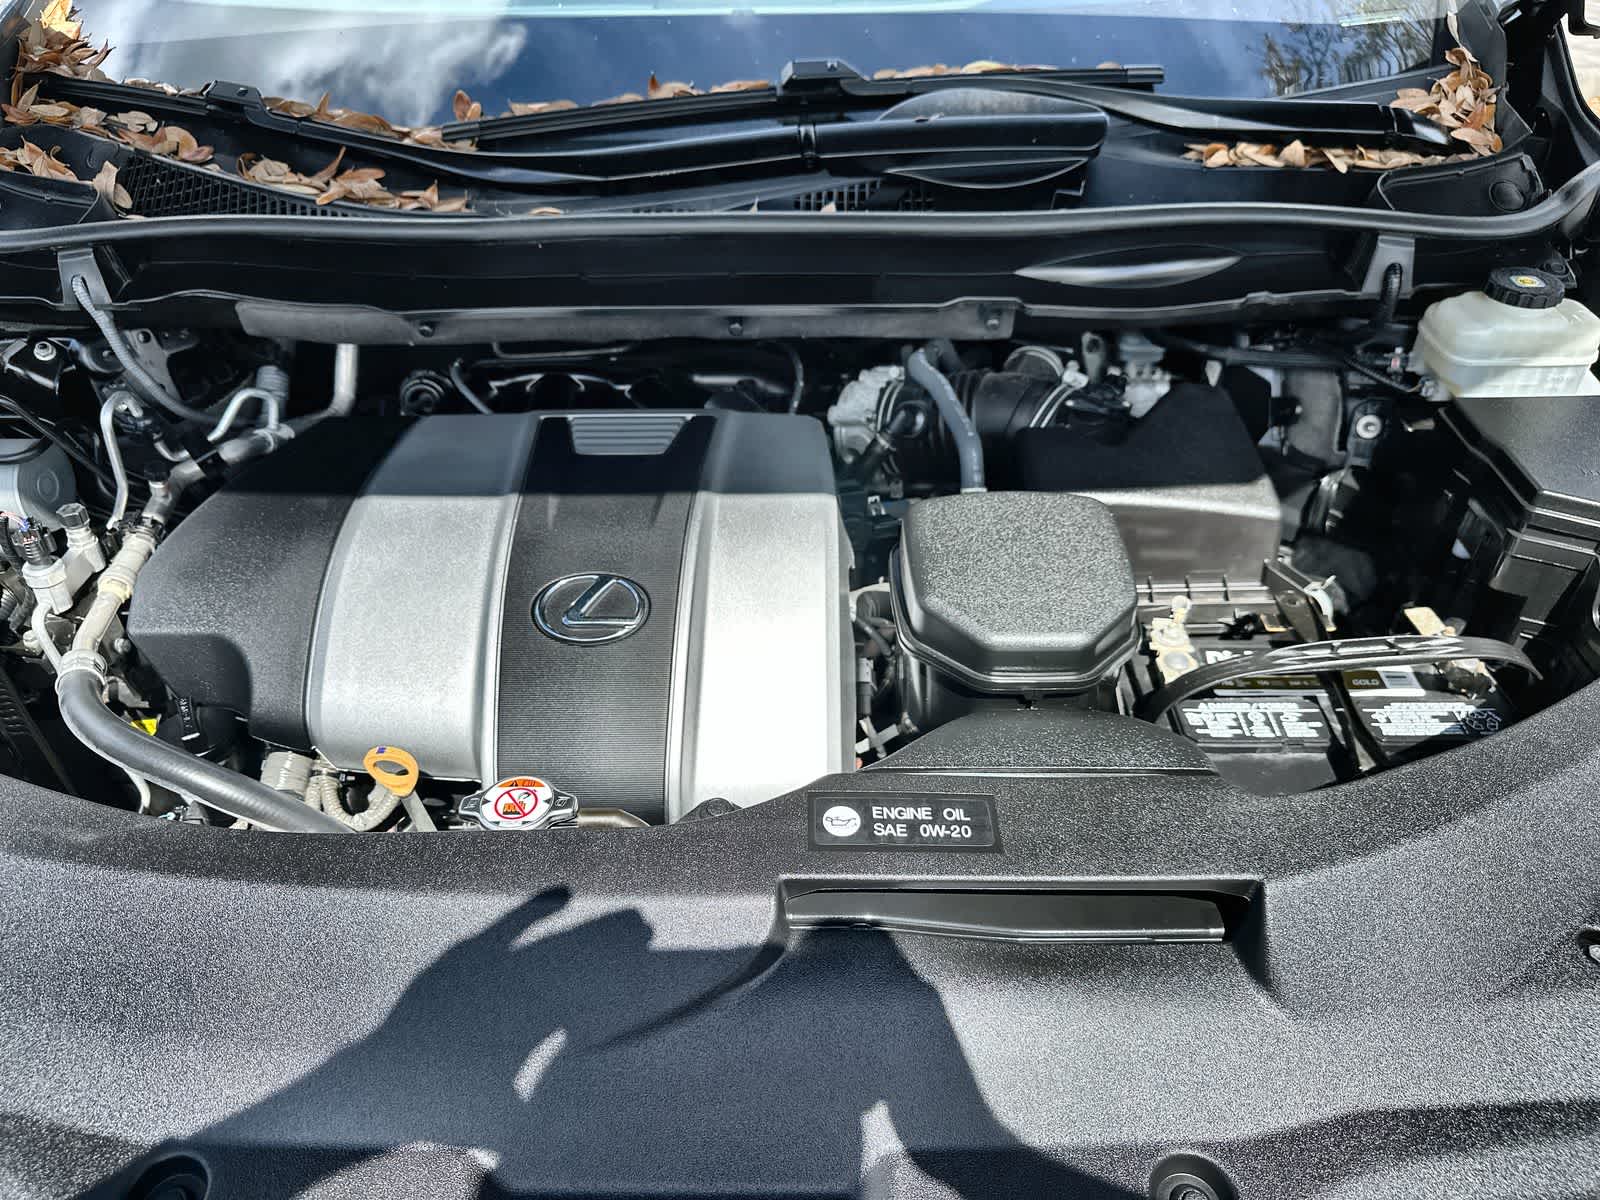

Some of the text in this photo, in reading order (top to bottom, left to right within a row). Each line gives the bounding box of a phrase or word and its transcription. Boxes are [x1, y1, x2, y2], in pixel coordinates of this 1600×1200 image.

[871, 806, 971, 821] ENGINE OIL
[873, 823, 972, 838] SAE 0W-20
